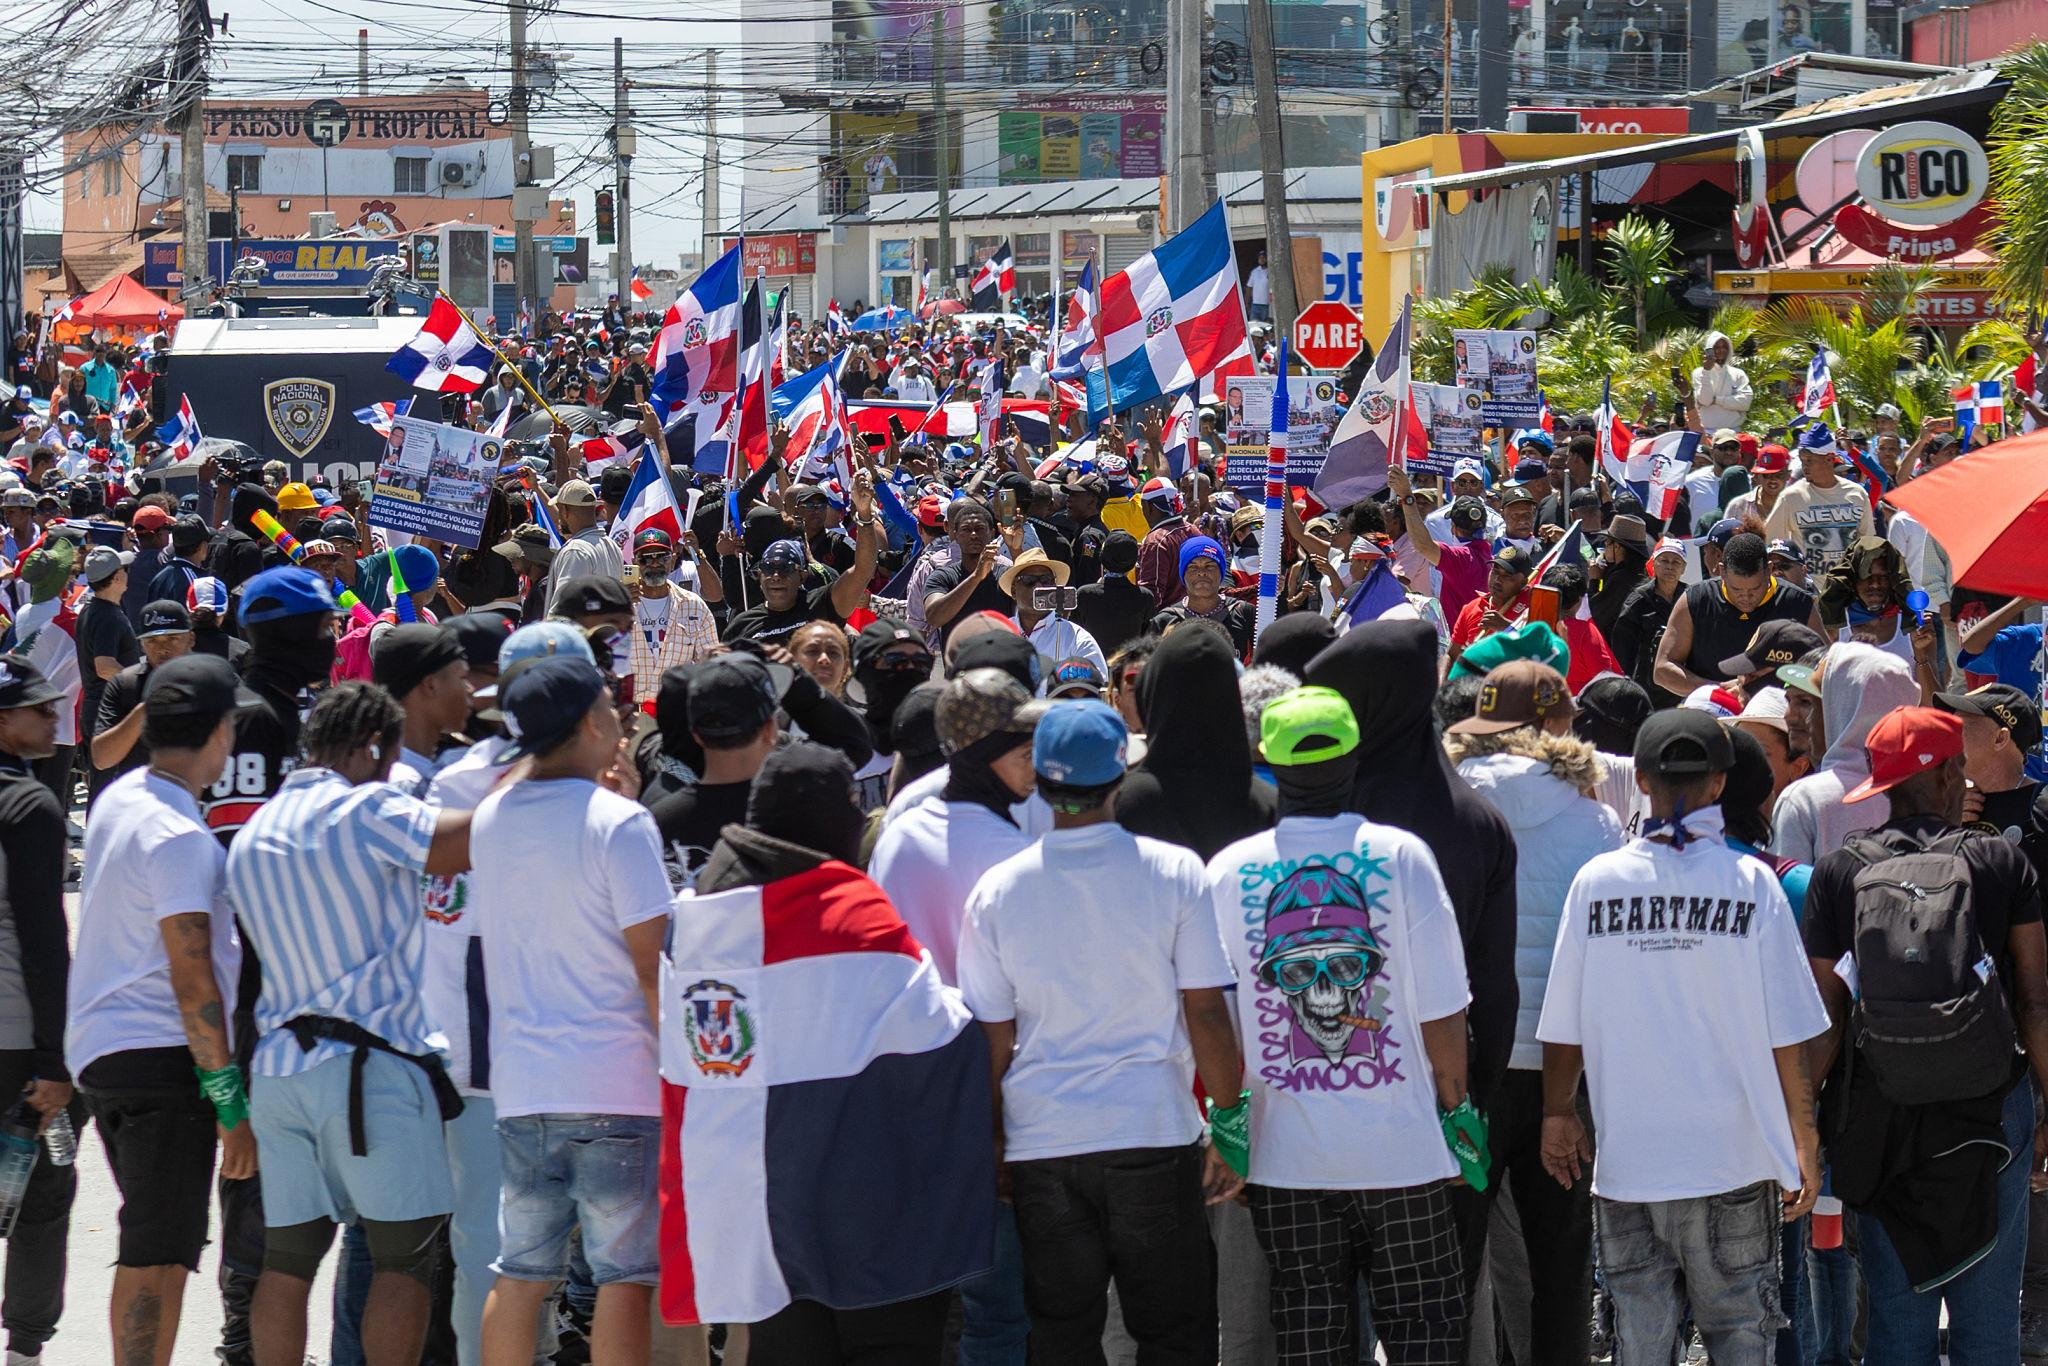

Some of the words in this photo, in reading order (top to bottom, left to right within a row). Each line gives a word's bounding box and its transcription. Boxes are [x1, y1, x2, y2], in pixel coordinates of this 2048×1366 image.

[354, 110, 486, 139] TROPICAL
[1881, 149, 1969, 200] RICO
[295, 245, 369, 271] REAL
[1888, 235, 1956, 257] Friusa
[1298, 323, 1358, 349] PARE
[272, 391, 327, 405] NACIONAL
[279, 383, 320, 394] POLICIA
[272, 409, 295, 445] REPUBLICA
[303, 407, 328, 446] DOMINICANA
[378, 488, 415, 500] NACIONALES
[369, 513, 384, 522] UNO
[384, 516, 393, 524] DE
[403, 520, 429, 532] PATRIA.
[373, 498, 391, 507] JOSE
[391, 501, 427, 515] FERNANDO
[449, 514, 480, 528] VOLQUEZ
[380, 507, 421, 522] DECLARADO
[421, 516, 452, 529] ENEMIGO
[451, 523, 481, 537] NUMERO
[1796, 506, 1864, 526] NEWS
[1767, 649, 1793, 661] AOD
[1994, 703, 2018, 726] AOD
[1588, 895, 1757, 938] HEARTMAN
